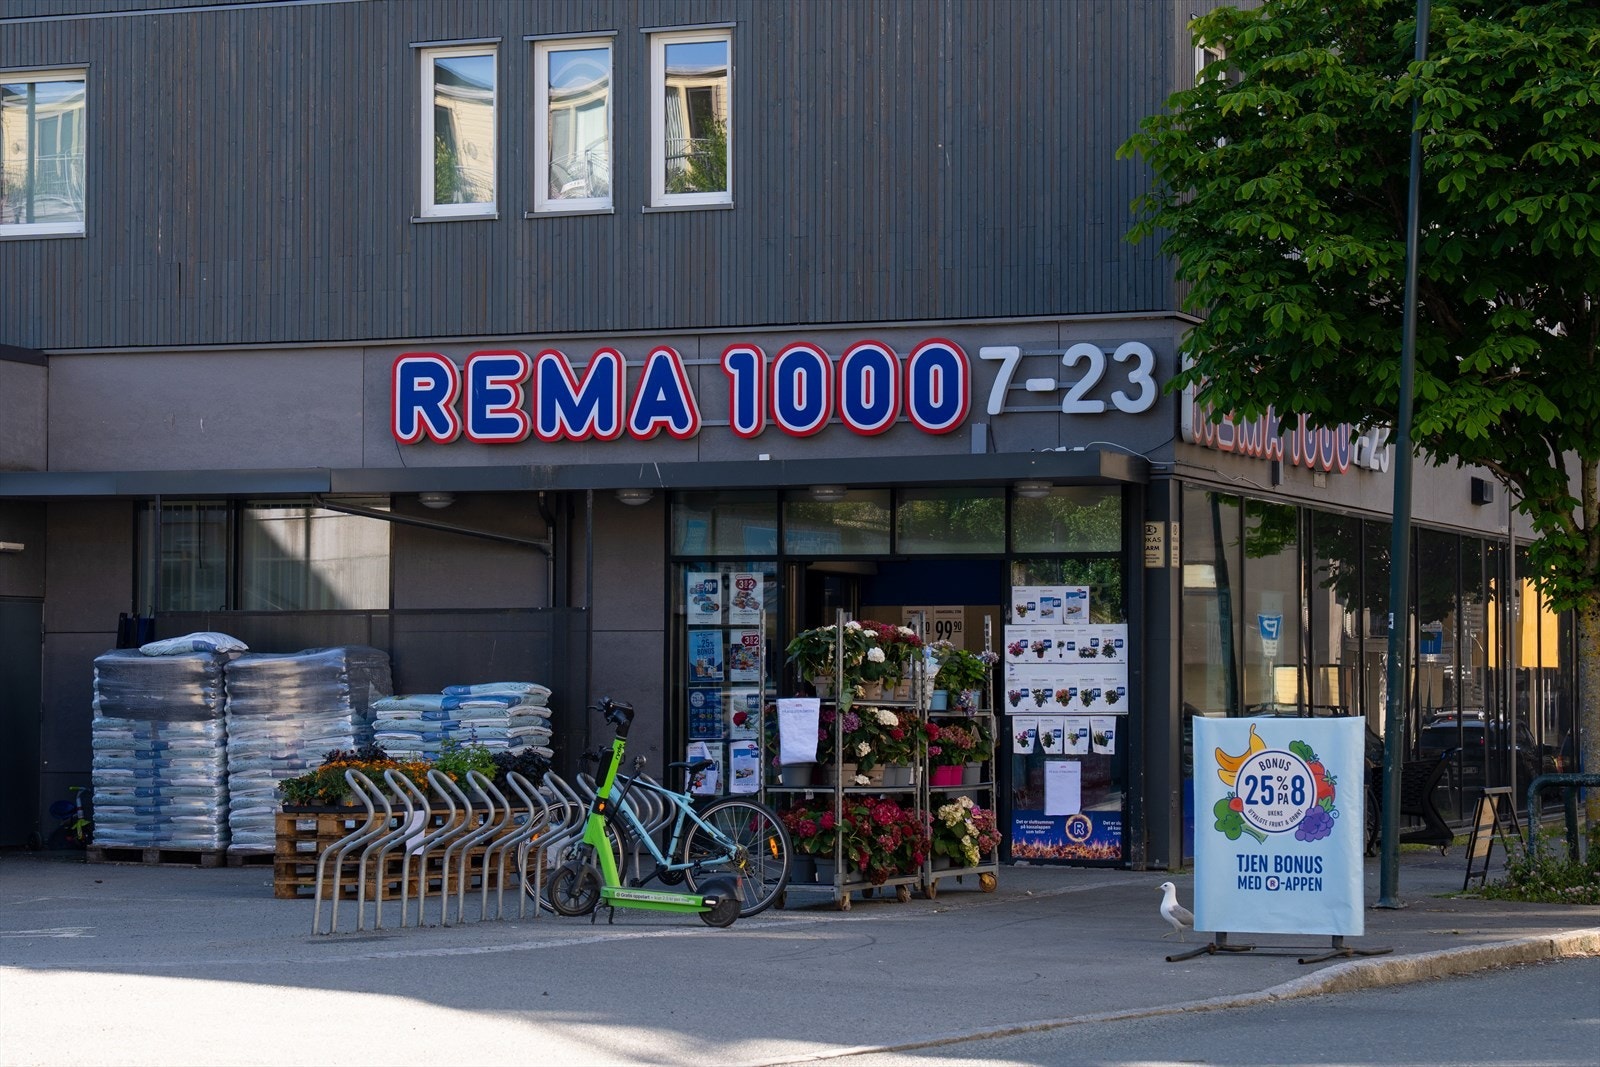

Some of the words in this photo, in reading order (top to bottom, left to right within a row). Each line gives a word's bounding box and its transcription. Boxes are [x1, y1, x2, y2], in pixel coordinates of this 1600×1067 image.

[391, 345, 702, 445] REMA
[720, 337, 971, 440] 1000
[979, 341, 1158, 415] 7-23
[935, 620, 953, 641] 99
[1258, 758, 1292, 771] BONUS
[1245, 774, 1274, 805] 25
[1291, 775, 1305, 806] 8
[1236, 854, 1268, 872] TJEN
[1274, 855, 1323, 874] BONUS
[1238, 876, 1262, 890] MED
